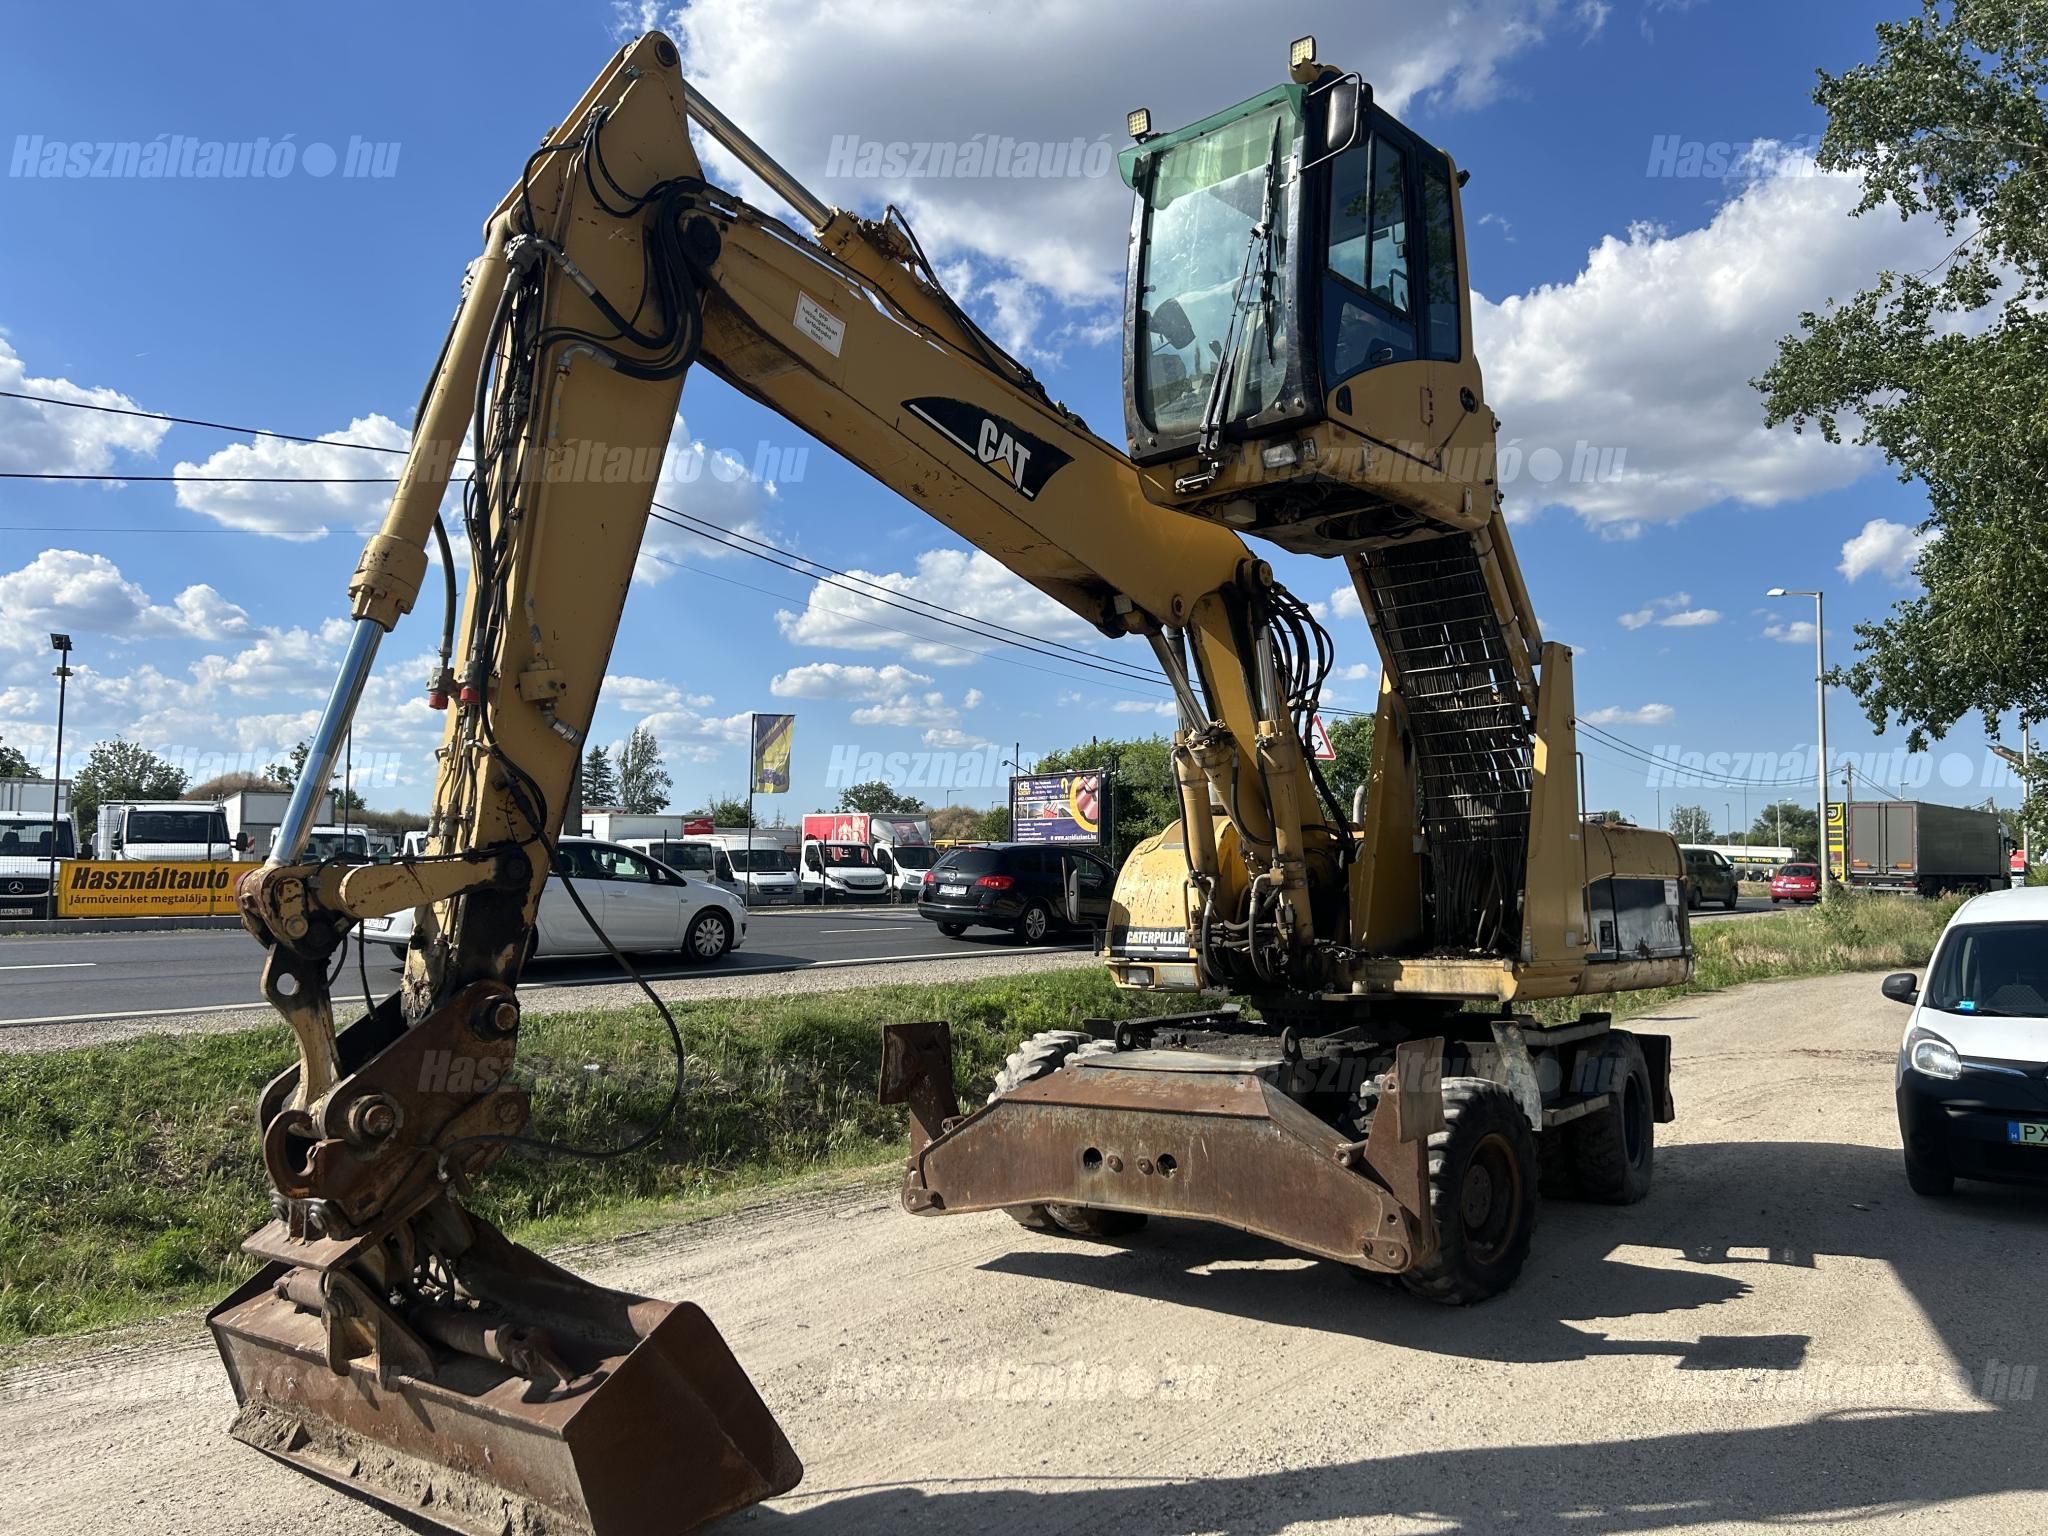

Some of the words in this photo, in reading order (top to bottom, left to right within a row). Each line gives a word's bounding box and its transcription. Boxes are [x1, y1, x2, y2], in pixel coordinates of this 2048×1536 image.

[977, 418, 1031, 489] CAT
[71, 867, 229, 889] Használtautó
[69, 894, 148, 905] Járműveinket
[151, 893, 208, 905] megtalálja
[1127, 931, 1186, 944] CATERPILLAR
